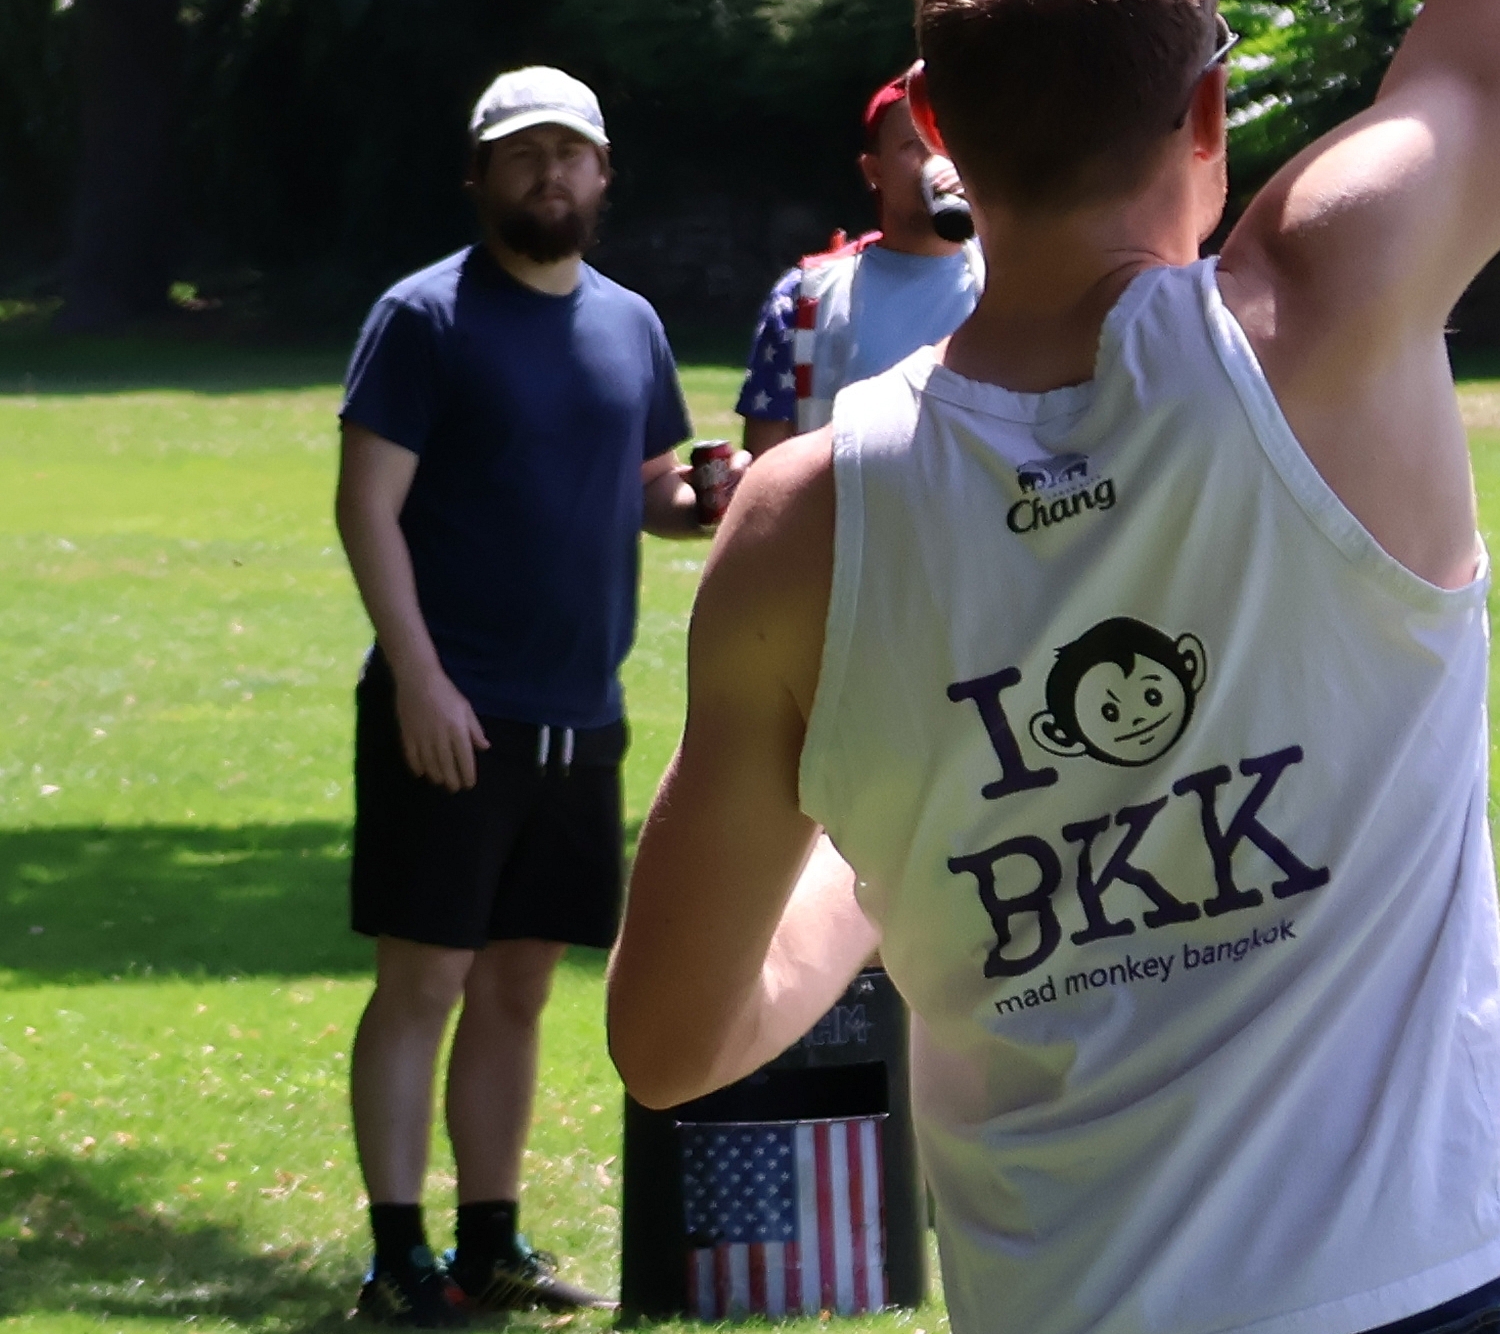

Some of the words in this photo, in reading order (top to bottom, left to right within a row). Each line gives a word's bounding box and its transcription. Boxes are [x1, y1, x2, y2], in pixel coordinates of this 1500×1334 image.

[1007, 478, 1116, 534] Chang
[947, 667, 1058, 799] I
[947, 745, 1330, 978] BKK
[994, 976, 1057, 1014] mad
[1064, 954, 1174, 996] monkey
[1183, 919, 1297, 969] bangkok
